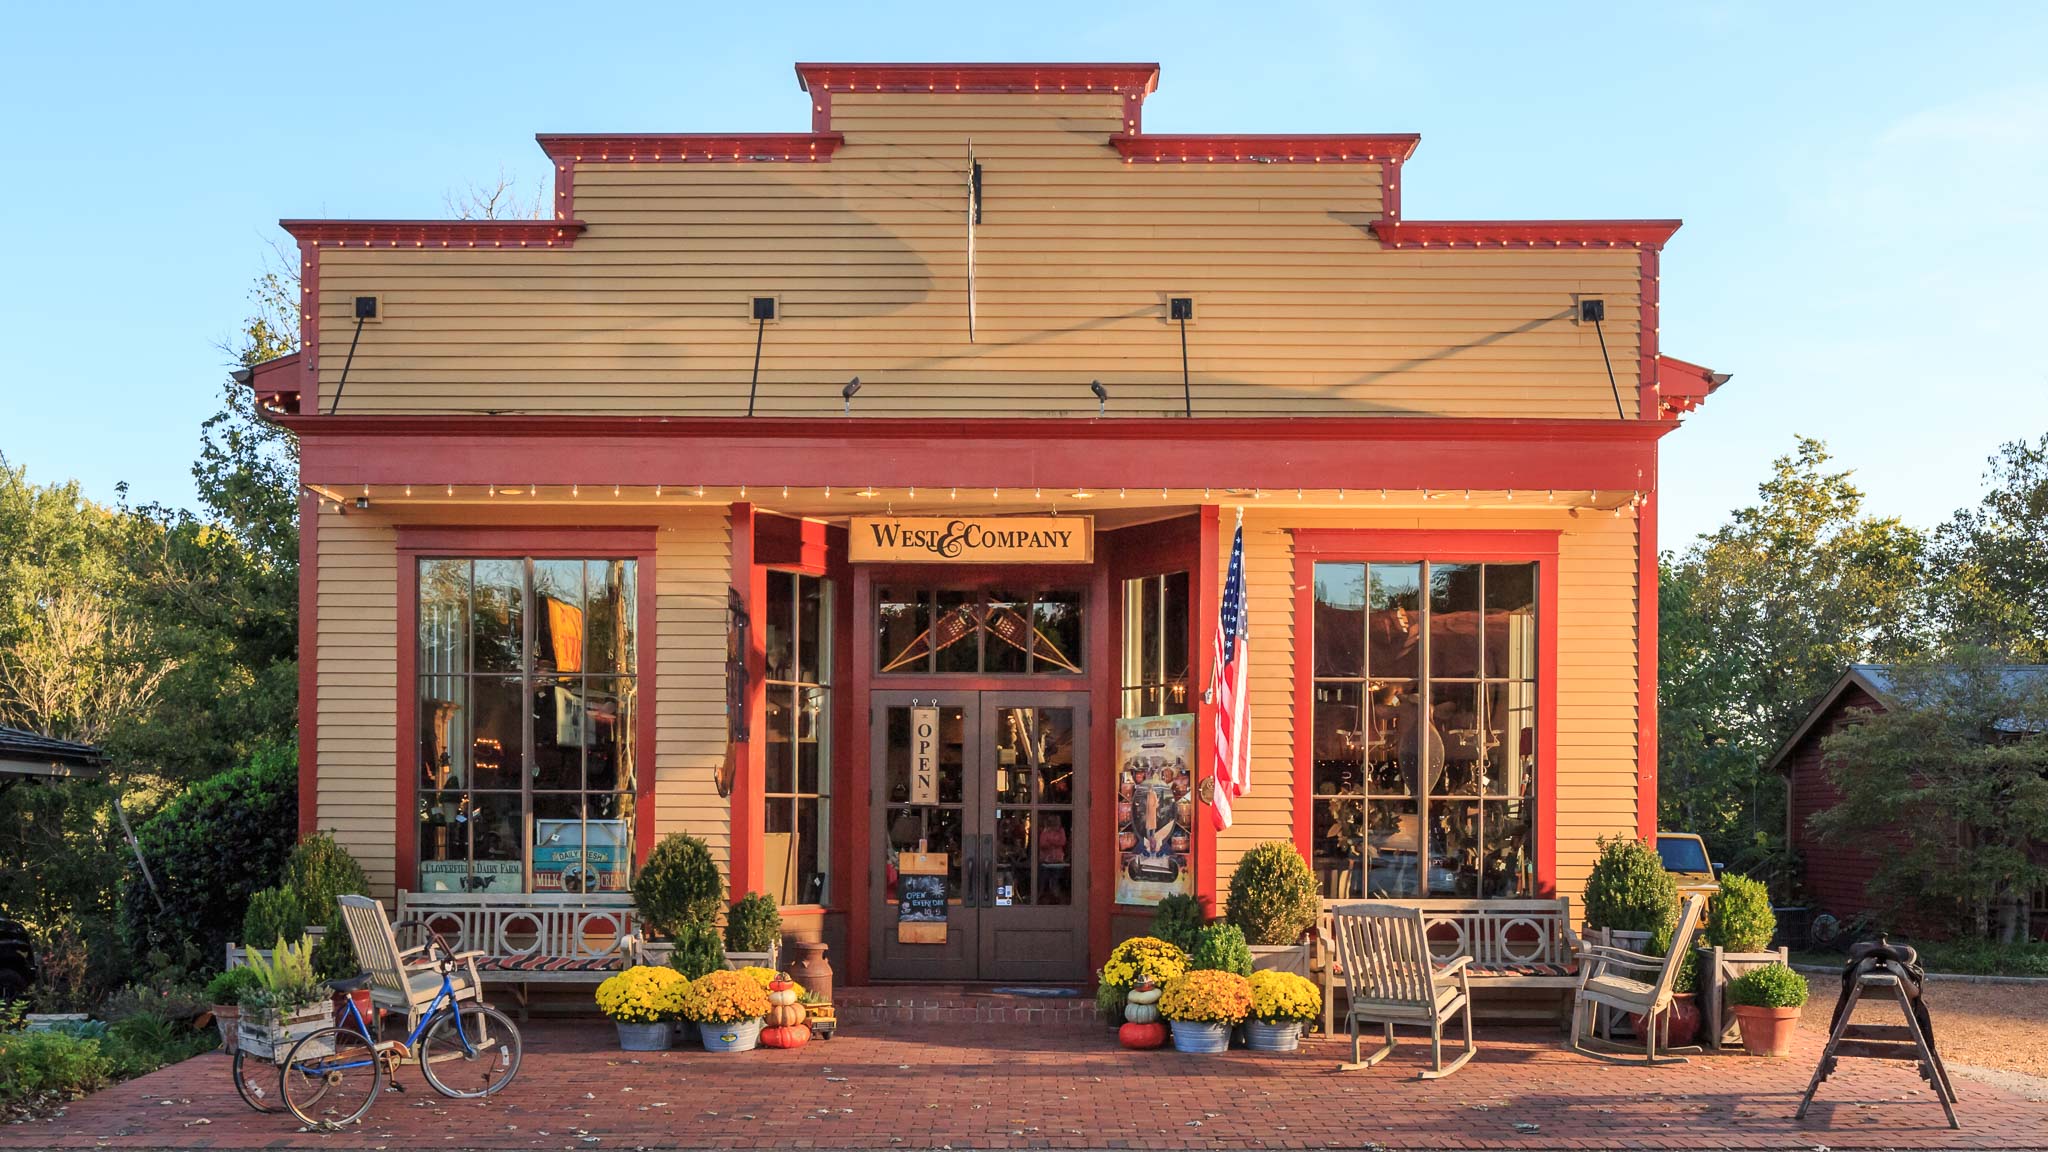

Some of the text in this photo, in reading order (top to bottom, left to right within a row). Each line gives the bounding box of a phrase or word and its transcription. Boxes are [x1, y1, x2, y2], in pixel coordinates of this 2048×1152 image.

[917, 723, 932, 789] OPEN
[559, 850, 603, 860] DAILY ESH
[477, 863, 497, 873] DAIRY
[500, 863, 519, 873] FARM
[536, 873, 561, 887] MILK
[601, 873, 626, 887] CREAM
